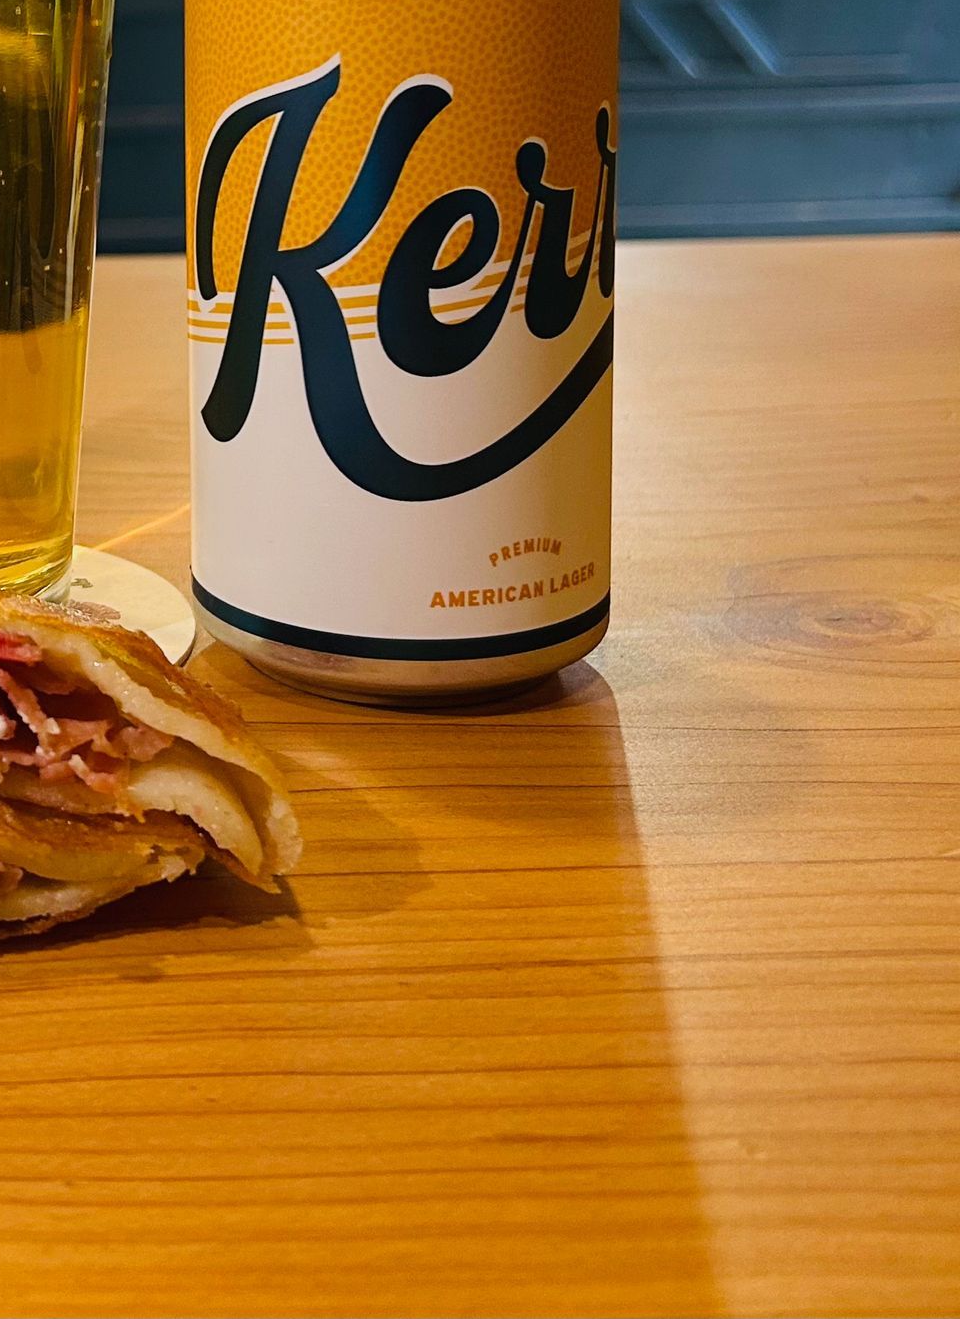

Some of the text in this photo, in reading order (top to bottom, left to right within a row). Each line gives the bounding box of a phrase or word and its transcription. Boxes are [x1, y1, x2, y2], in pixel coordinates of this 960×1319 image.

[488, 537, 562, 568] PREMIUM
[430, 561, 595, 608] AMERICAN LAGER
